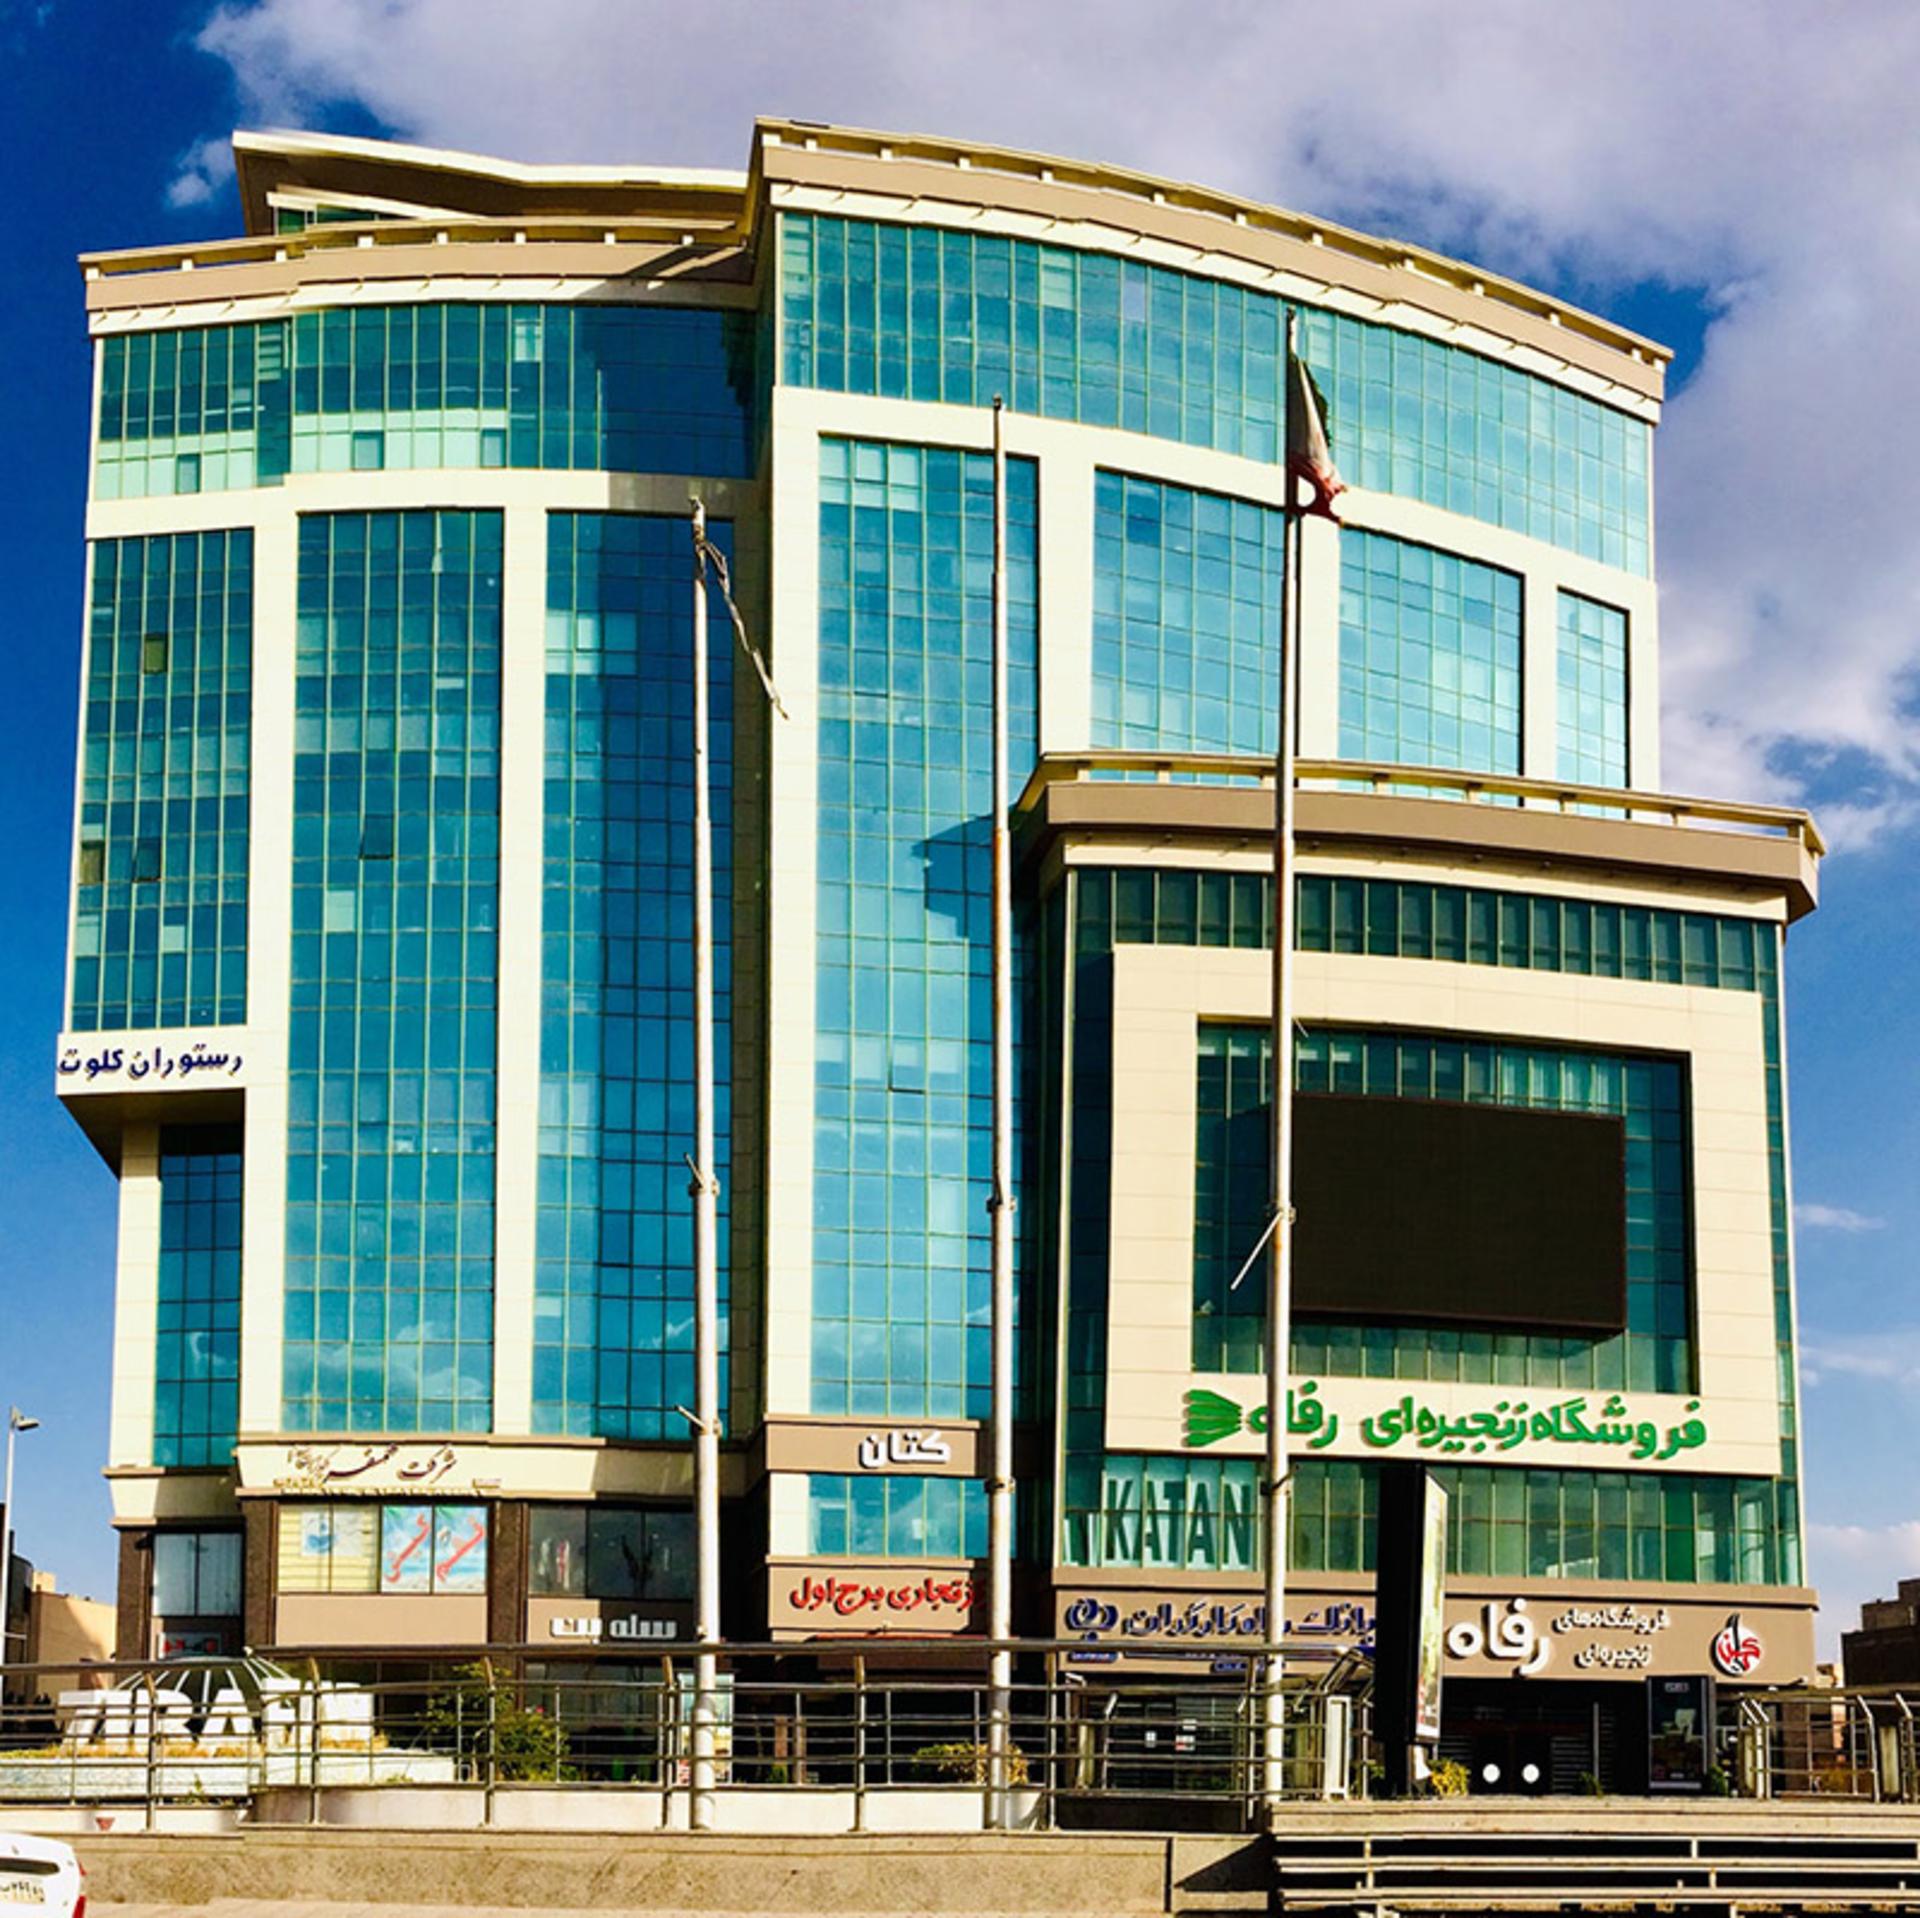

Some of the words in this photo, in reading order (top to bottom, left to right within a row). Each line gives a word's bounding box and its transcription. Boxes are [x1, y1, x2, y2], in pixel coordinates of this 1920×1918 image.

[58, 1048, 124, 1080] کلوت
[129, 1044, 243, 1079] رستوران
[1531, 1396, 1707, 1459] فروشگاه
[861, 1430, 951, 1467] کتان
[1105, 1479, 1253, 1566] KATAN
[790, 1576, 836, 1611] اول
[834, 1580, 885, 1614] برج
[888, 1577, 962, 1611] تجاری
[1121, 1602, 1247, 1637] کارگران
[1447, 1598, 1550, 1675] رفاه
